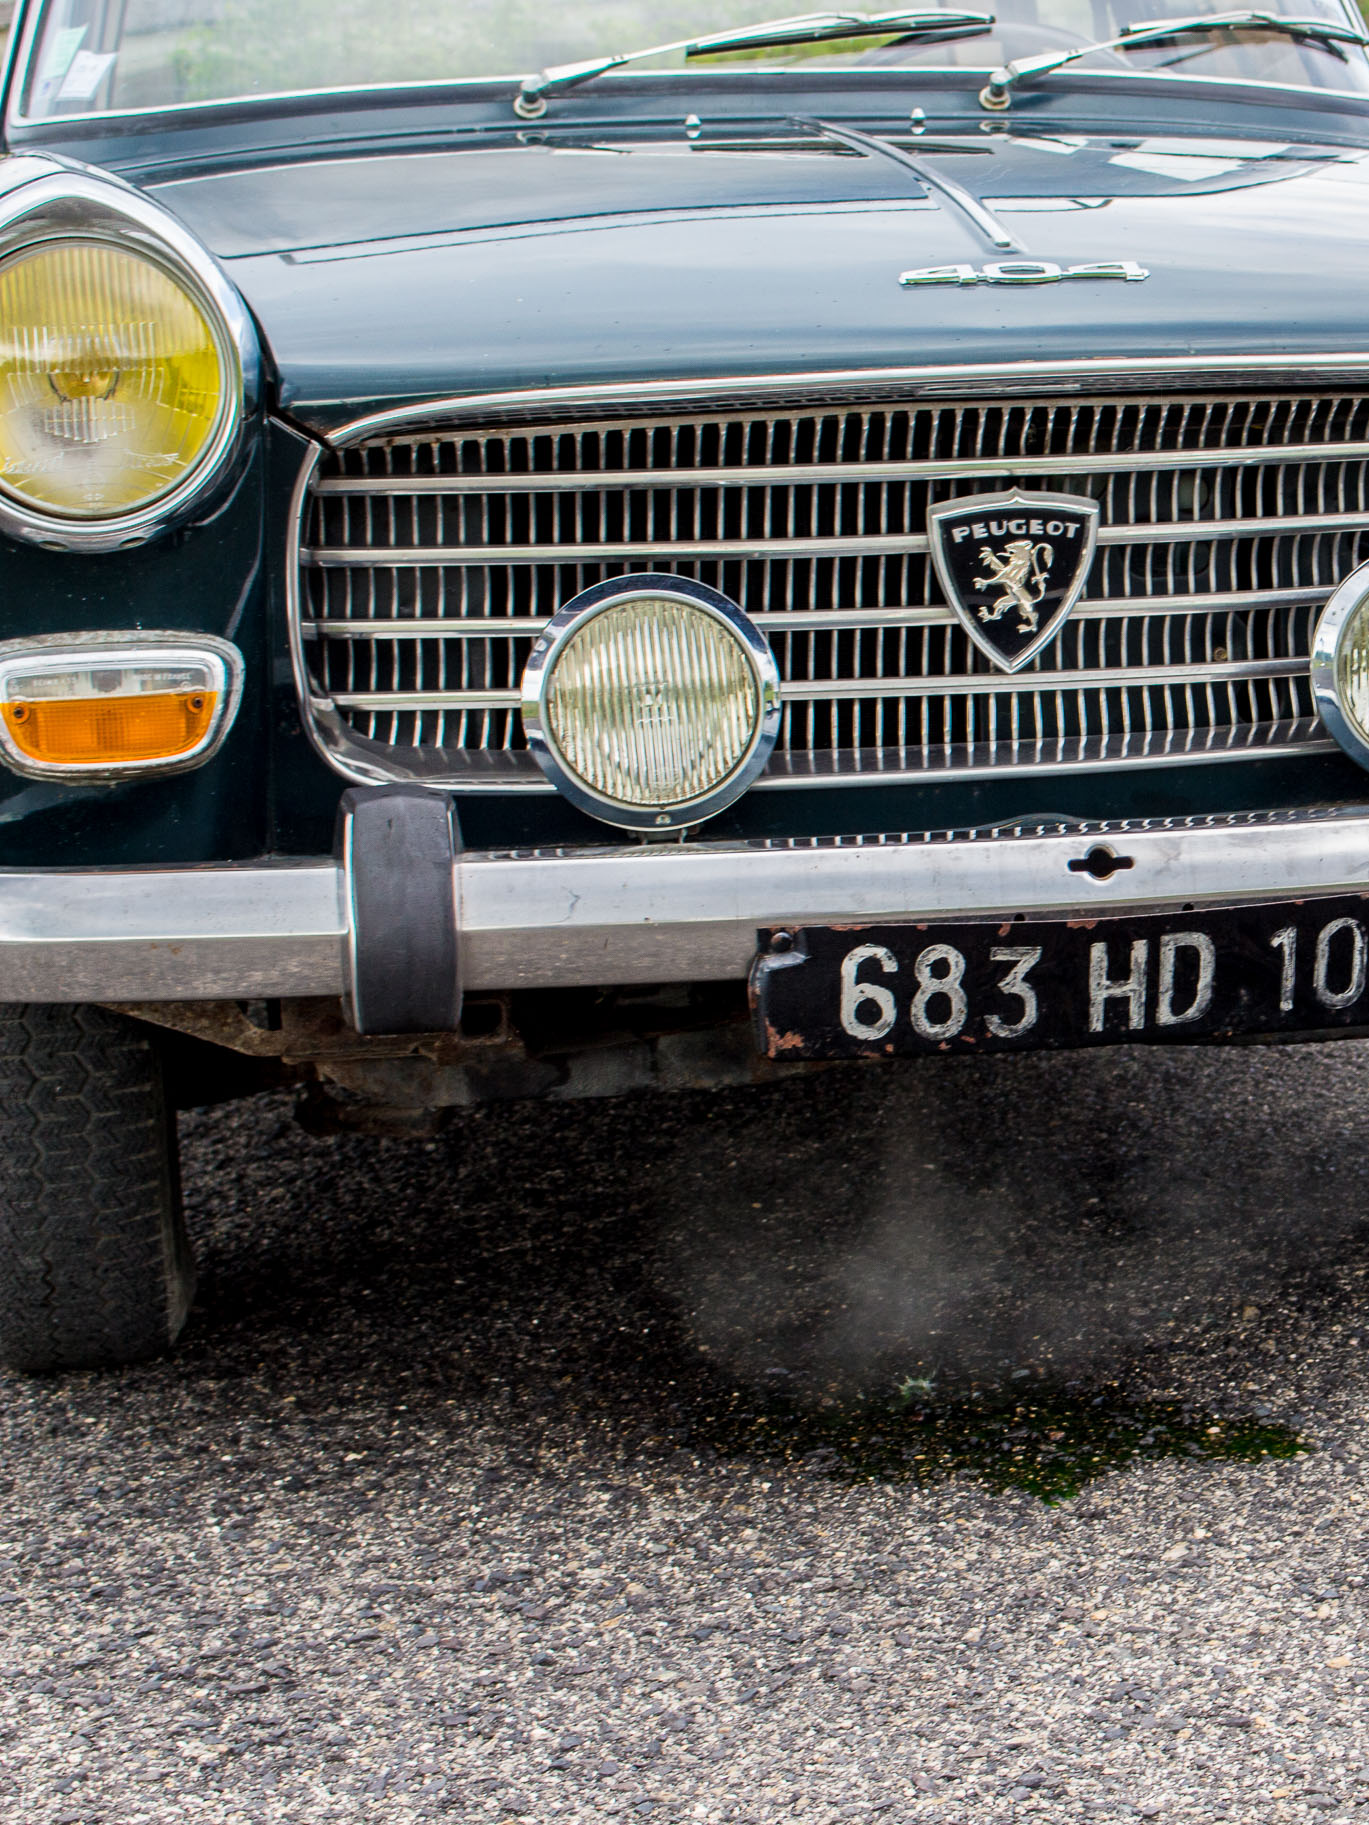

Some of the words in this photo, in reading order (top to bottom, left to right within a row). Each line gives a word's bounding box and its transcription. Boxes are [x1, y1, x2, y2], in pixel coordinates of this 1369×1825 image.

[898, 261, 1150, 284] 404
[951, 519, 1081, 543] PEUGEOT
[840, 942, 1043, 1040] 683
[1088, 931, 1214, 1033] HD
[1269, 917, 1368, 1012] 10
